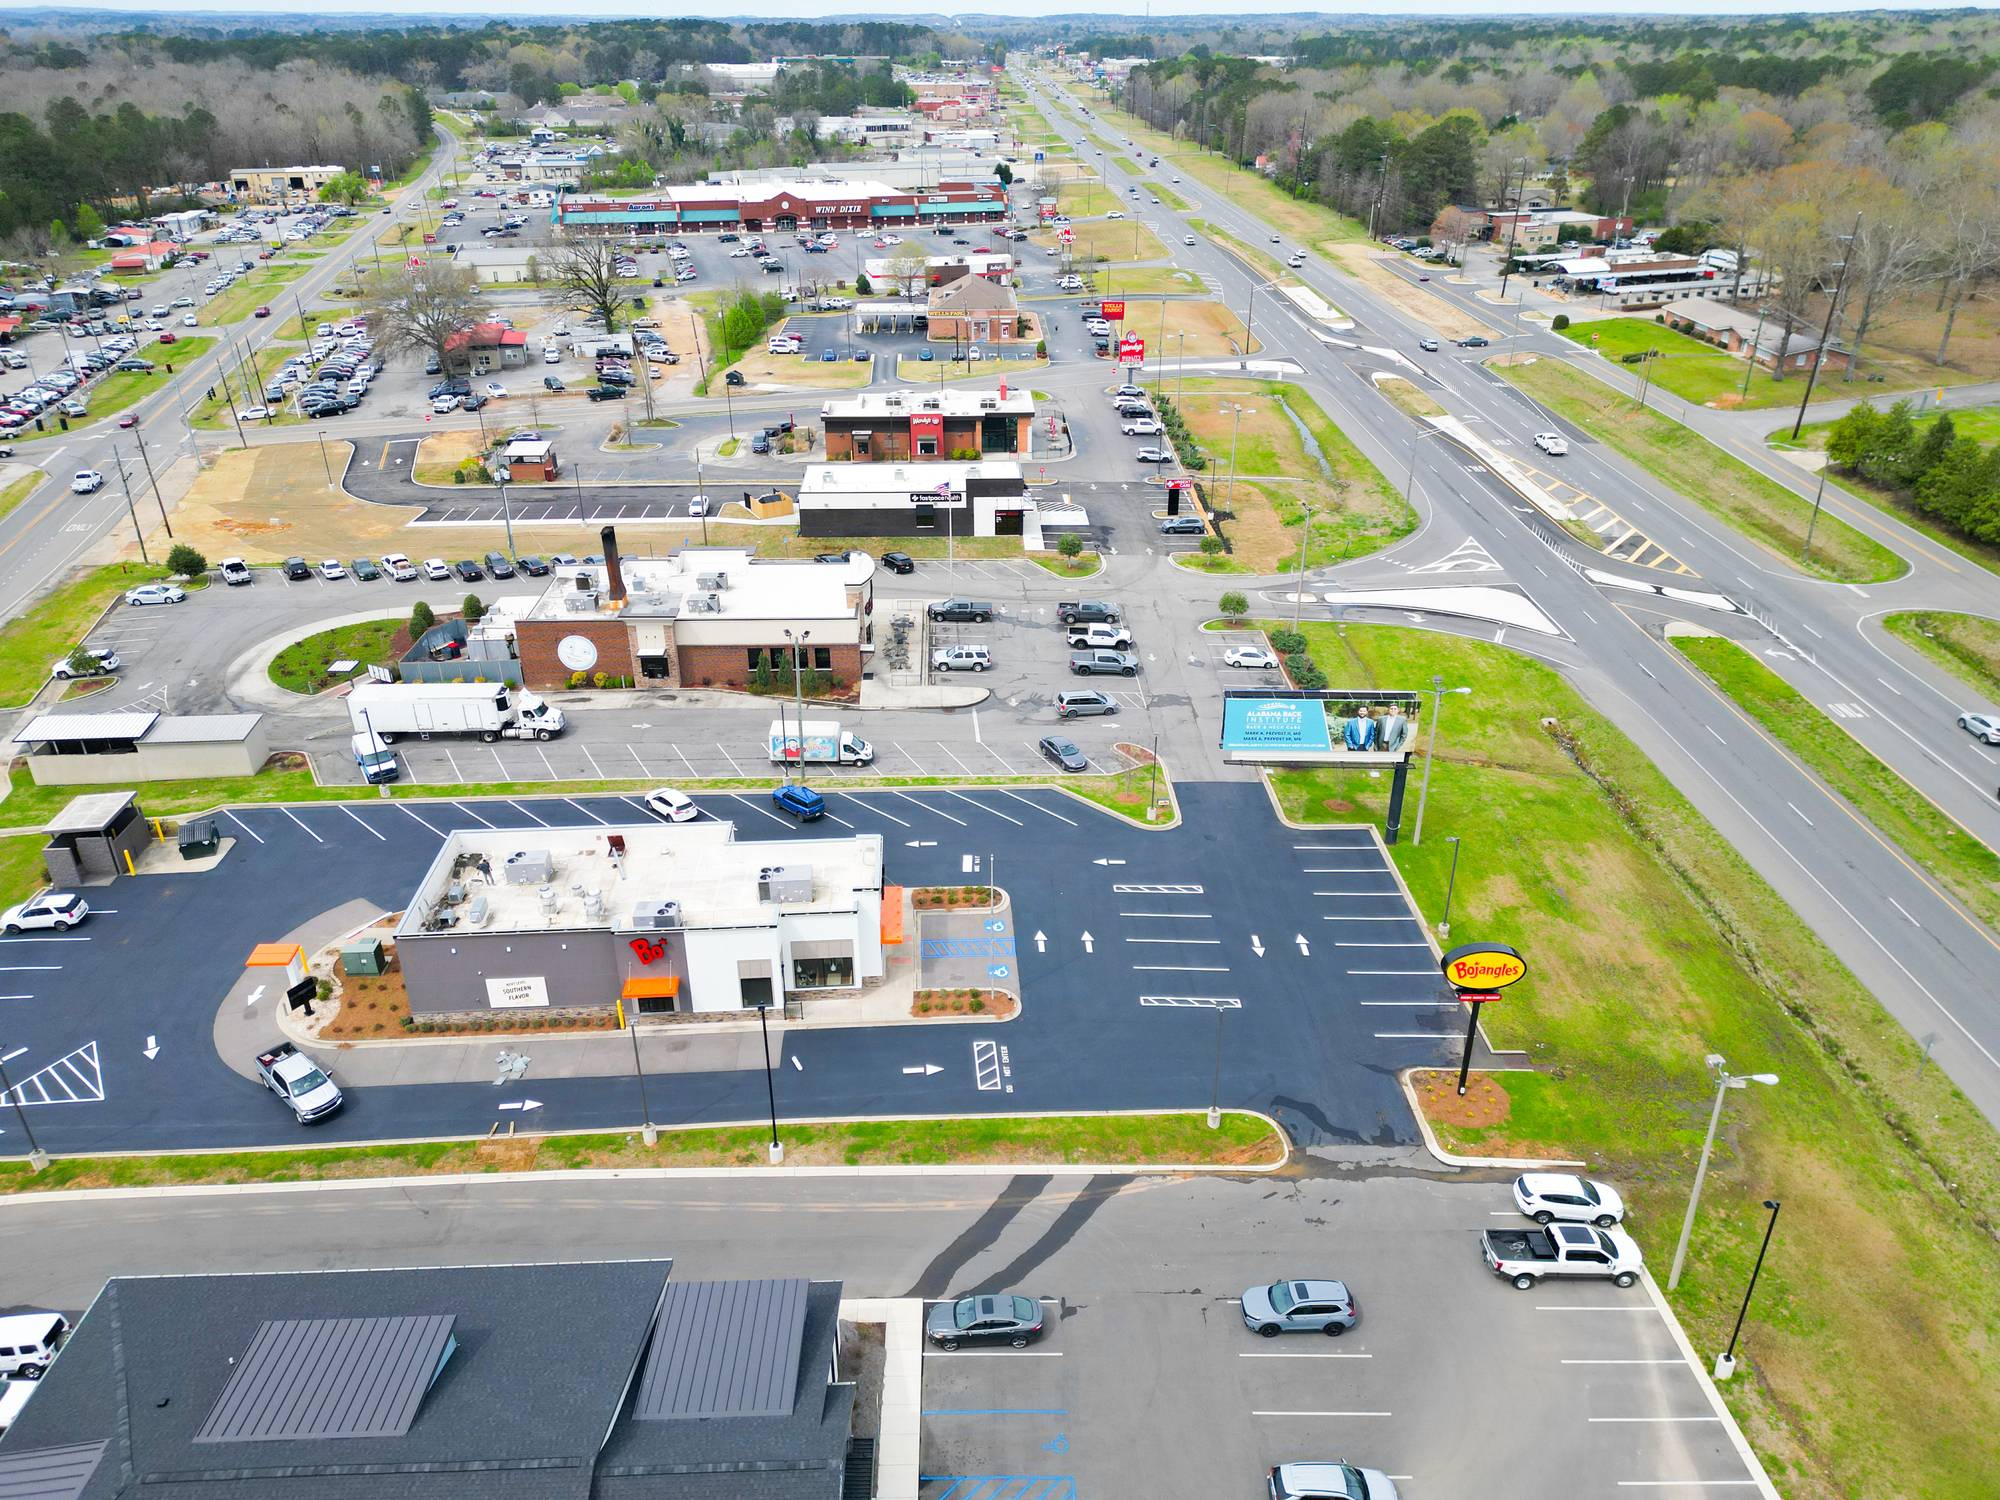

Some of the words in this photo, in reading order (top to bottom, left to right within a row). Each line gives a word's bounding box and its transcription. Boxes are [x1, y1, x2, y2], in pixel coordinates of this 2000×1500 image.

[815, 206, 836, 214] WINN
[839, 205, 862, 213] DIXIE
[1121, 342, 1143, 353] Wendy's
[1453, 961, 1519, 980] Bojangles
[502, 985, 532, 995] SOUTHERN
[508, 992, 530, 1001] FLAVOR
